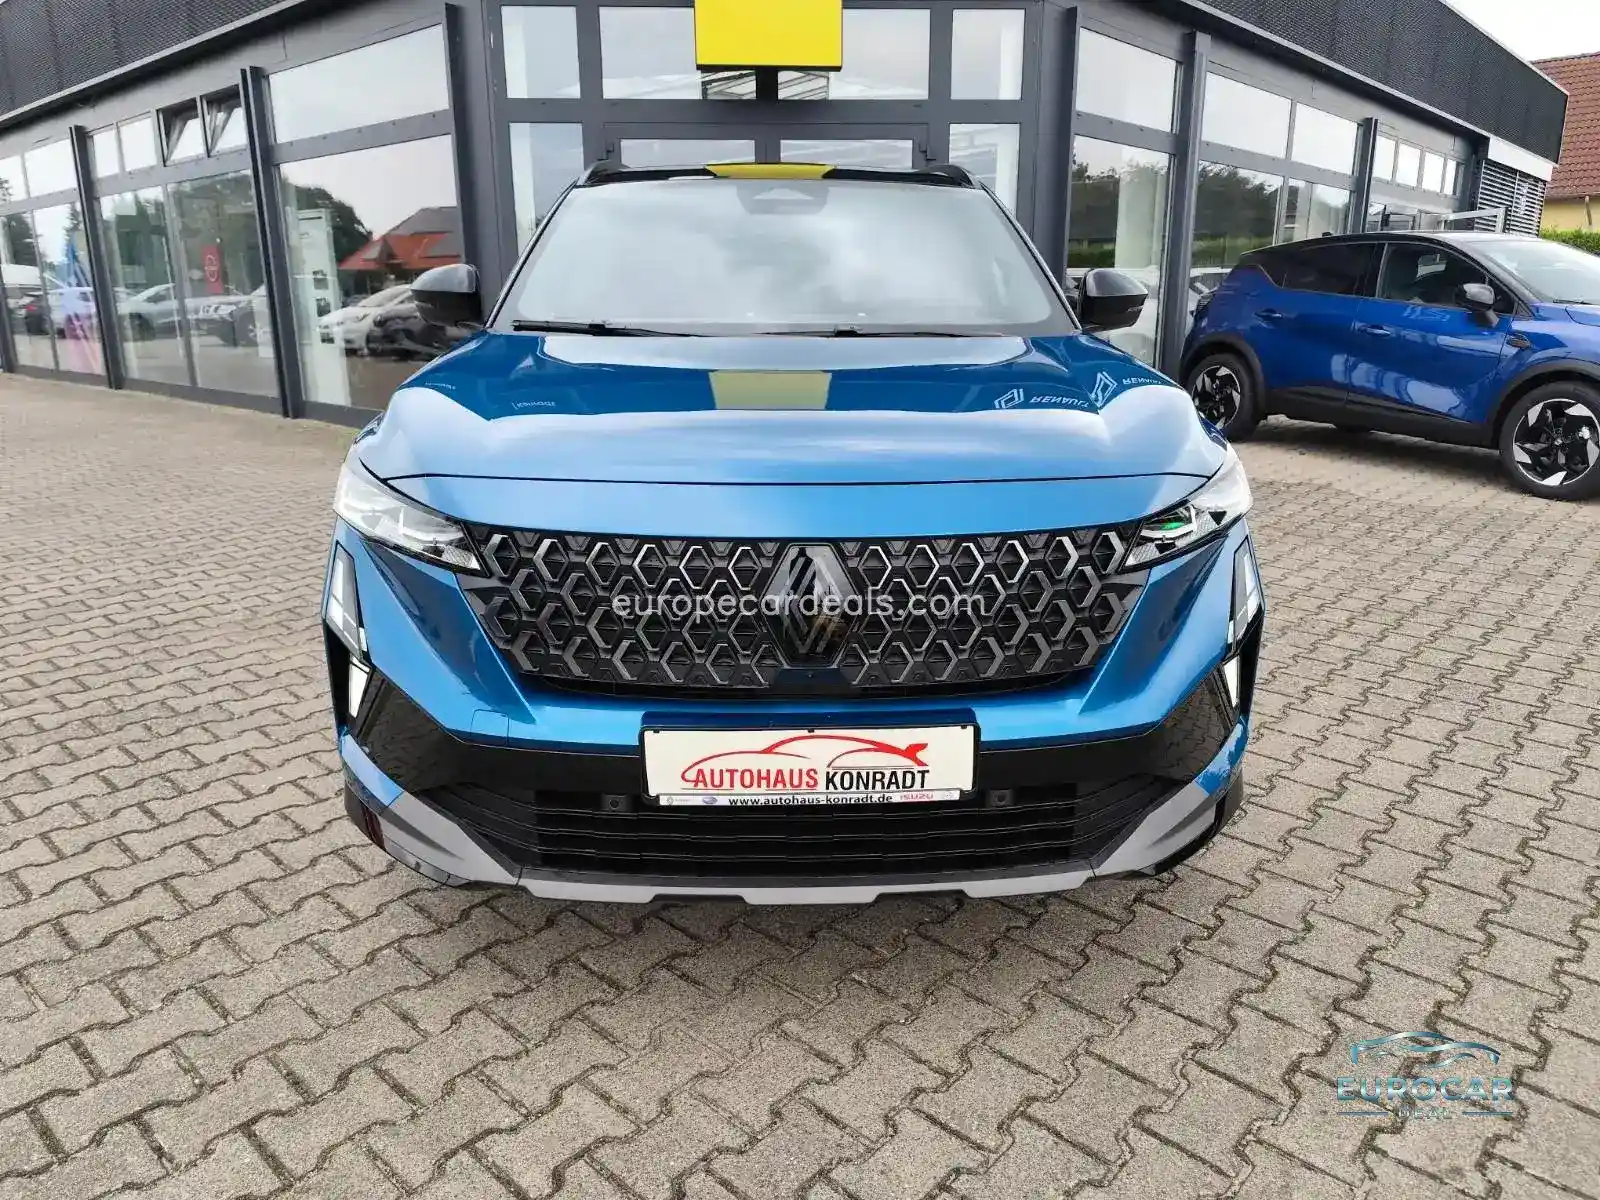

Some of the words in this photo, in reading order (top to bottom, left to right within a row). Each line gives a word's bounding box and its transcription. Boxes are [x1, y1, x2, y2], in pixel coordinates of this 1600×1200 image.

[694, 768, 819, 789] AUTOHAUS
[826, 770, 929, 790] KONRADT
[728, 794, 893, 806] www.autohaus-konradt.de
